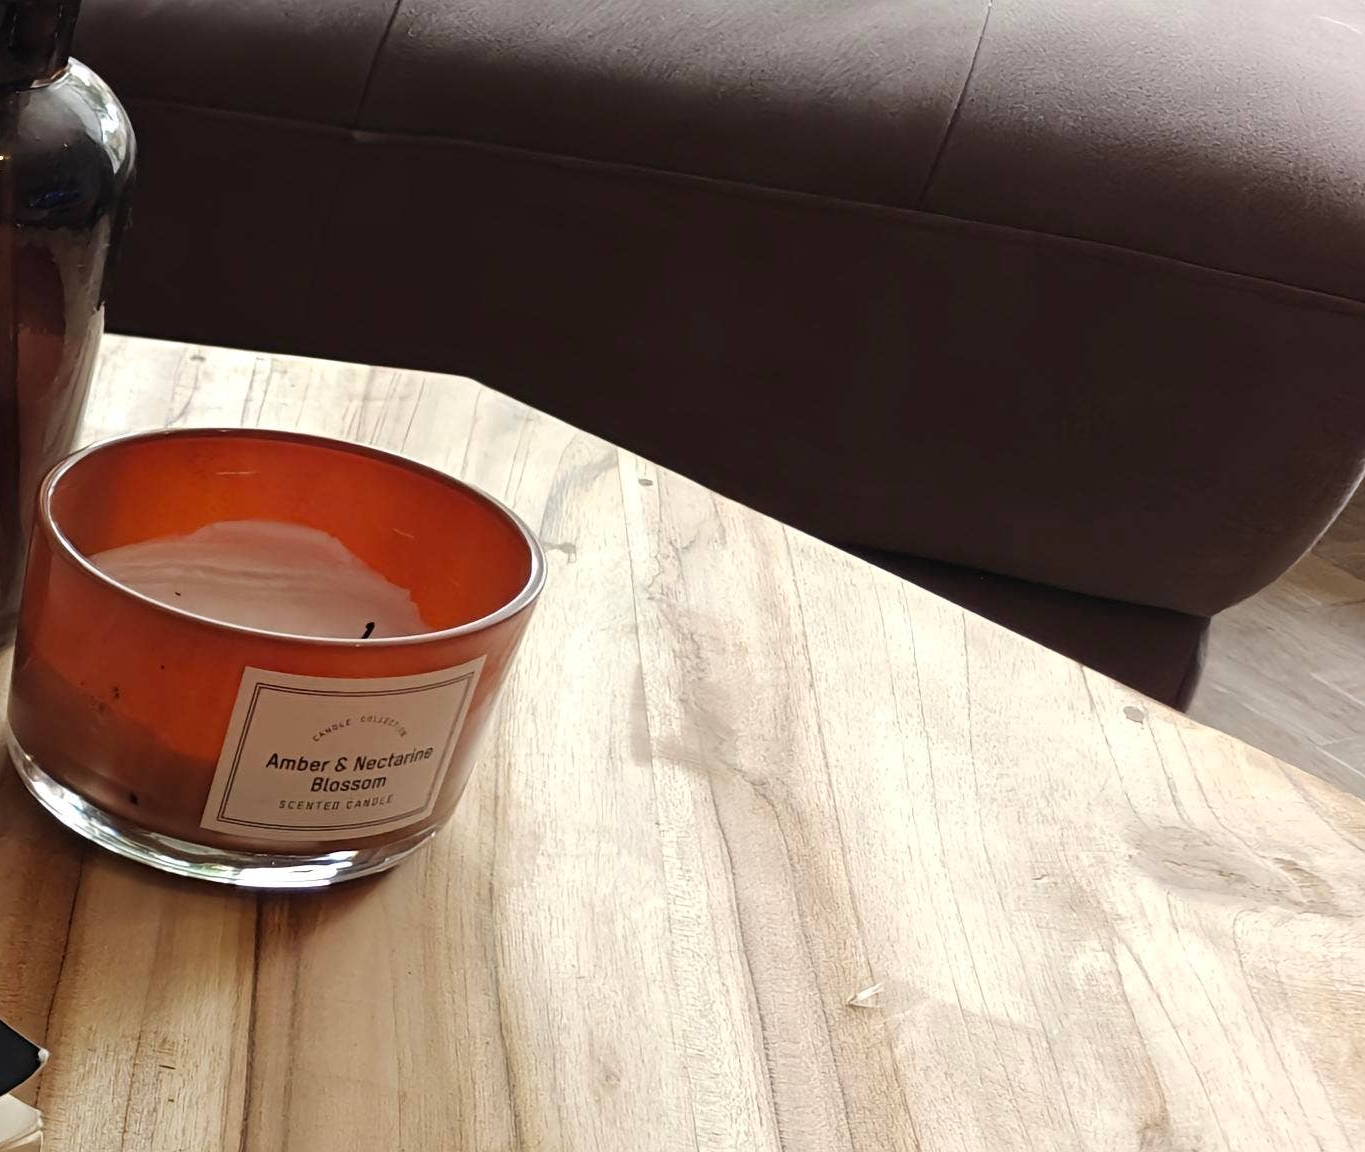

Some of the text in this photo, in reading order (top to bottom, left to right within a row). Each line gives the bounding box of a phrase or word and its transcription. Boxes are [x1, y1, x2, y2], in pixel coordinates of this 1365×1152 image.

[312, 718, 352, 742] CANDLE
[265, 746, 434, 773] Amber & Nectarine
[310, 775, 387, 793] Blossom
[278, 794, 394, 811] SCENTED CANDLE
